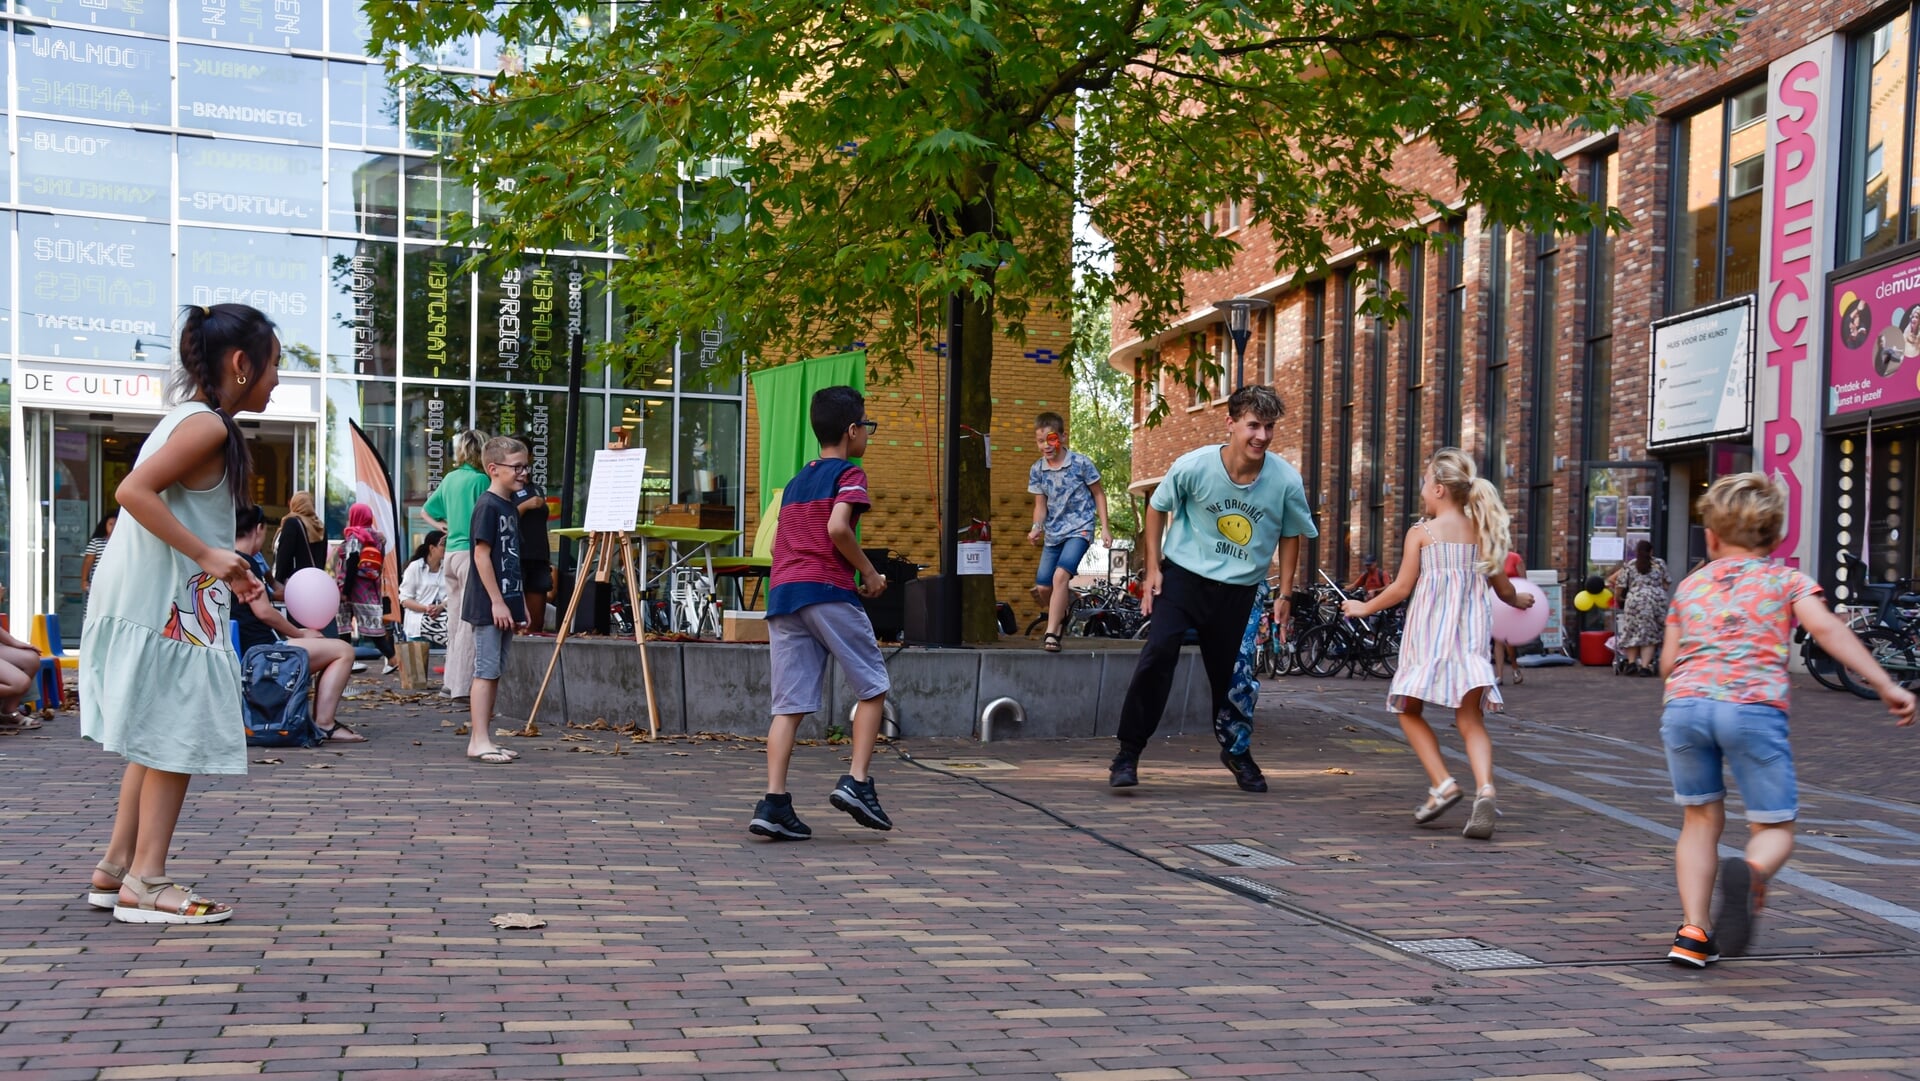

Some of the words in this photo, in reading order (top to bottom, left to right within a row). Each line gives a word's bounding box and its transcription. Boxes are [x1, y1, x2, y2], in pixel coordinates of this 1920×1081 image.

[34, 237, 136, 268] SOKKE
[351, 256, 375, 361] WANTEN
[499, 267, 521, 369] SPREIEN
[567, 271, 583, 348] BORSTRO
[1763, 60, 1820, 570] SPECTRU
[36, 313, 156, 336] TAFELKLEDEN
[1681, 336, 1697, 345] VOOR
[1698, 333, 1706, 341] DE
[1708, 328, 1728, 339] KUNST
[25, 373, 54, 391] DE
[1834, 380, 1860, 394] Ontdek
[1860, 377, 1872, 389] de
[1853, 393, 1861, 403] in
[1861, 387, 1883, 405] jezelf
[1206, 502, 1224, 514] THE
[1225, 499, 1264, 524] ORIGINAL
[1215, 541, 1249, 561] SMILEY
